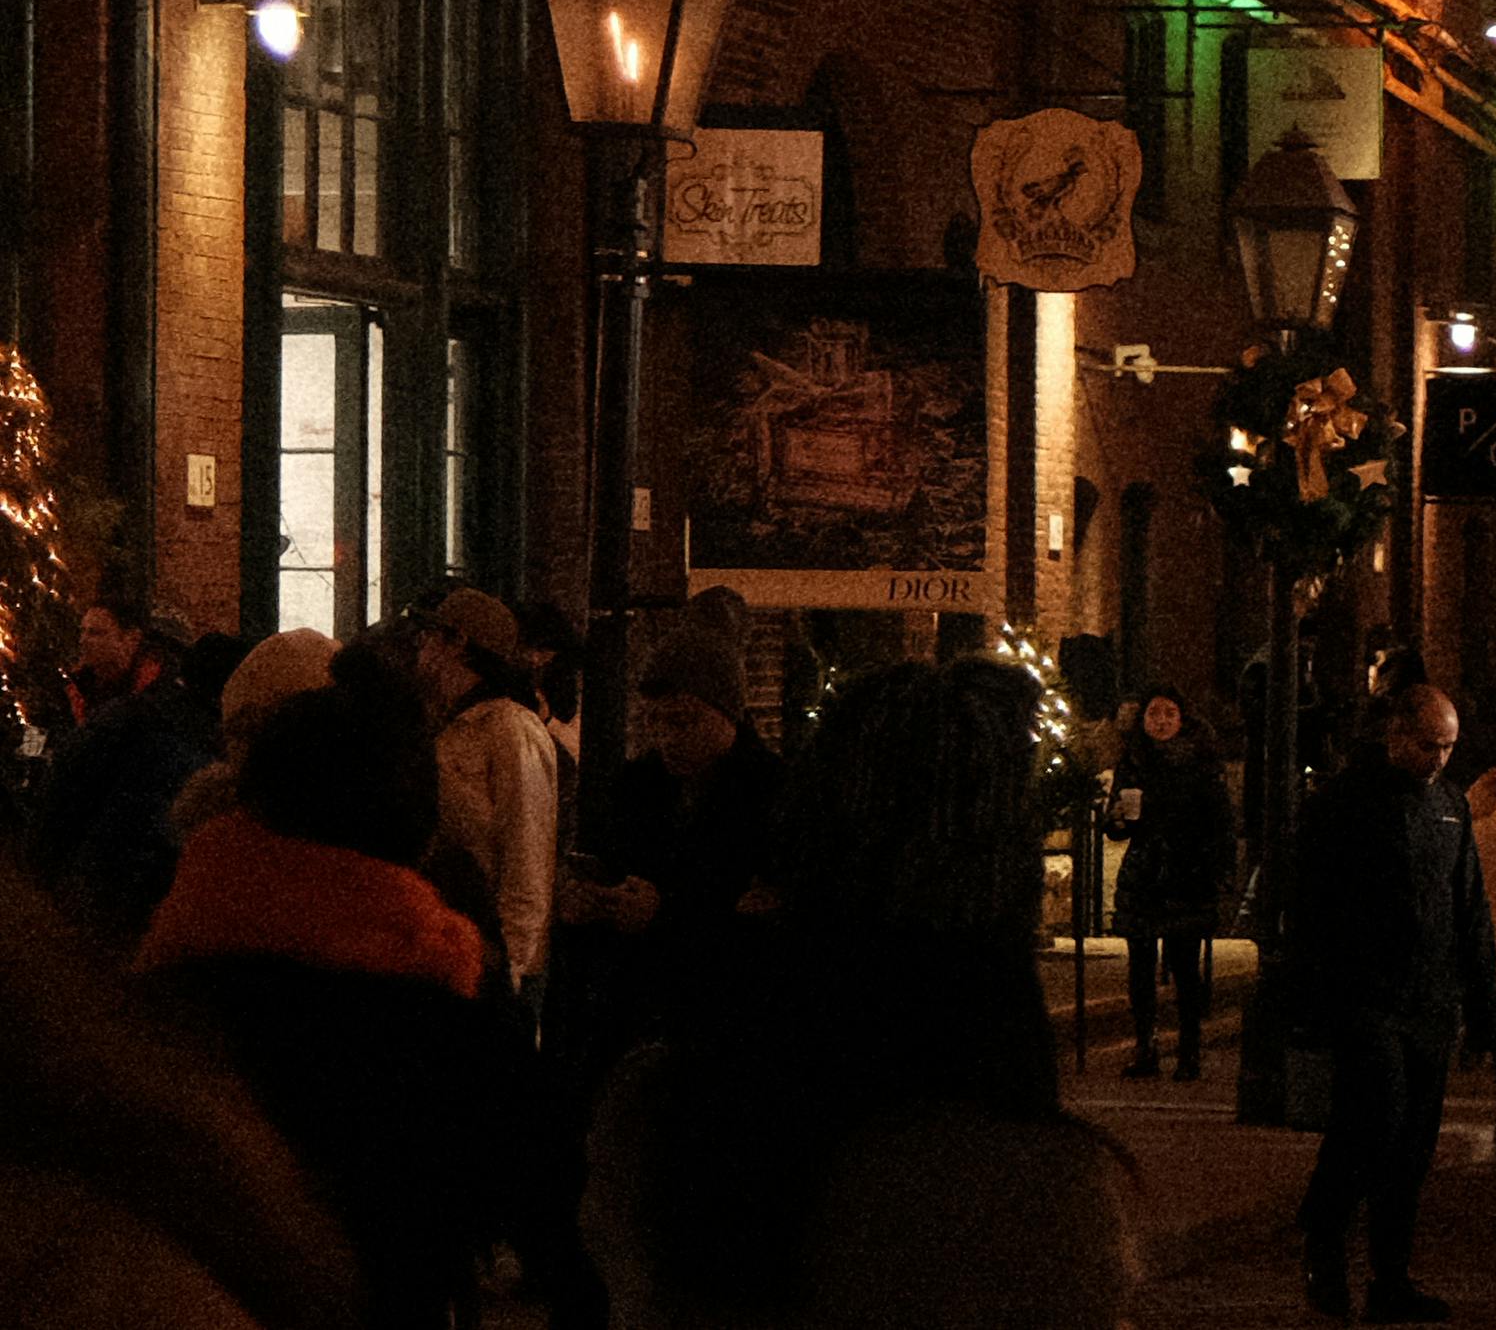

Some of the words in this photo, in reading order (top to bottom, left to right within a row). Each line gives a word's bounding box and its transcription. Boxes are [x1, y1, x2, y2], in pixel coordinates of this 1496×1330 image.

[676, 182, 733, 223] Skin
[732, 187, 807, 225] Treats
[888, 577, 972, 601] DIOR
